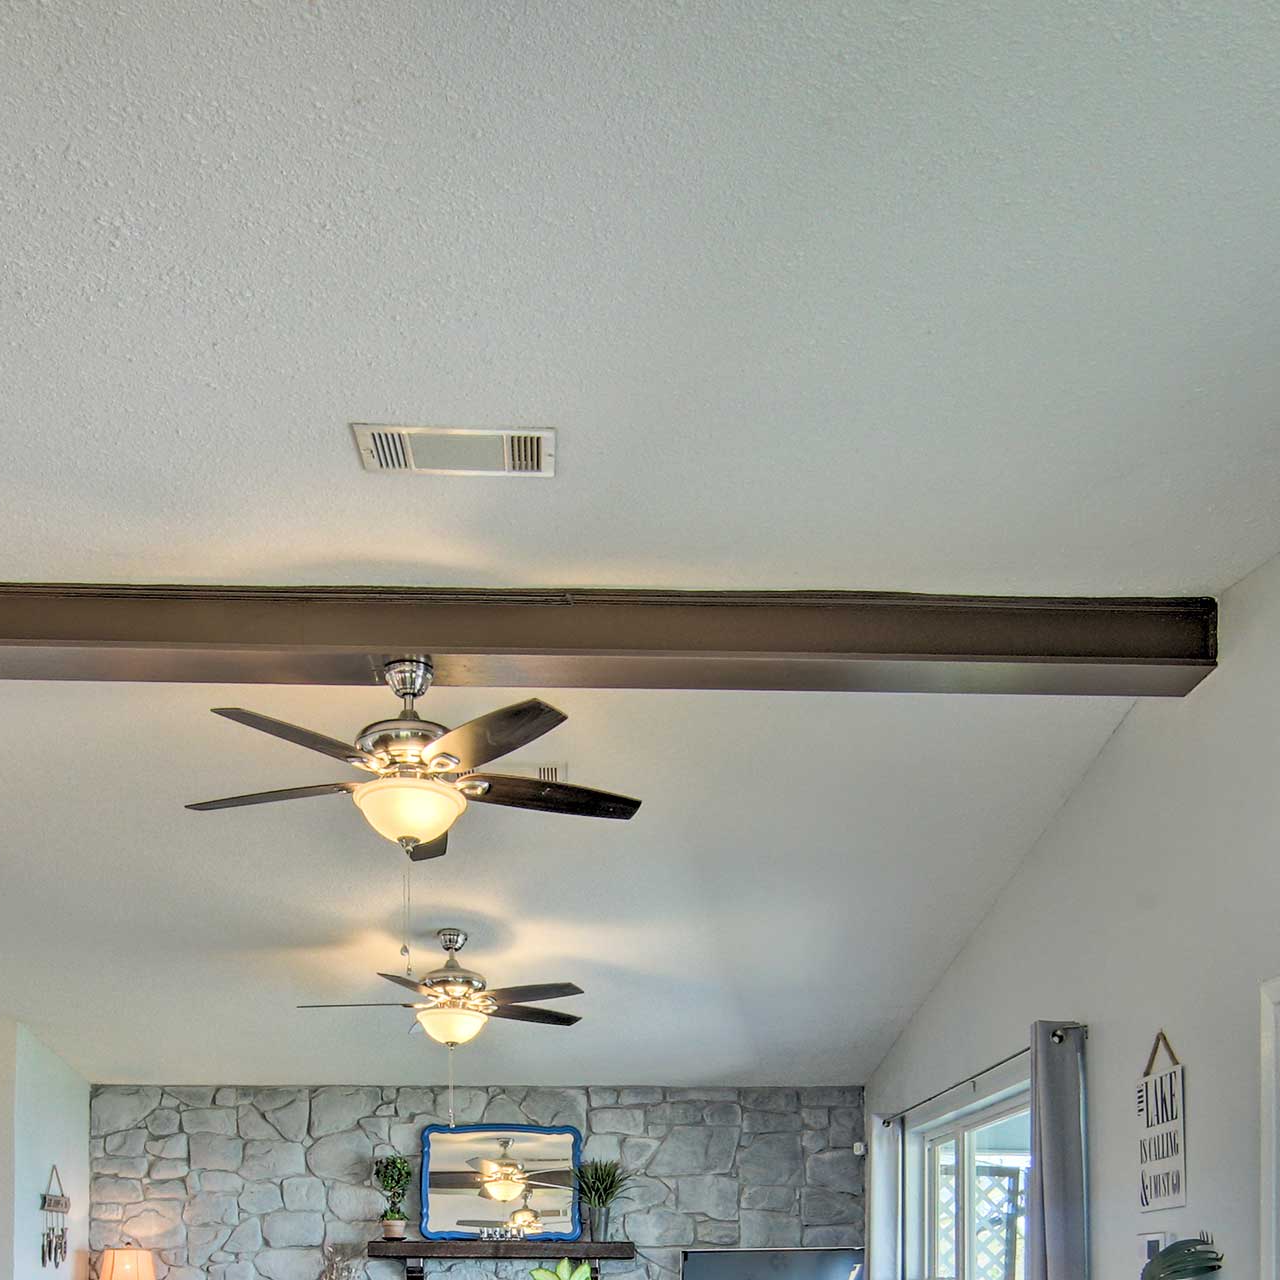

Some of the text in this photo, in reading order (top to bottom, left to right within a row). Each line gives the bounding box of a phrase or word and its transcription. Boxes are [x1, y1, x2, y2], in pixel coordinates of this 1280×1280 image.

[1145, 1071, 1178, 1128] LAKE
[1140, 1130, 1179, 1164] IS CALLING
[1140, 1169, 1149, 1207] &
[1153, 1172, 1170, 1198] MUST
[1171, 1169, 1180, 1195] GO
